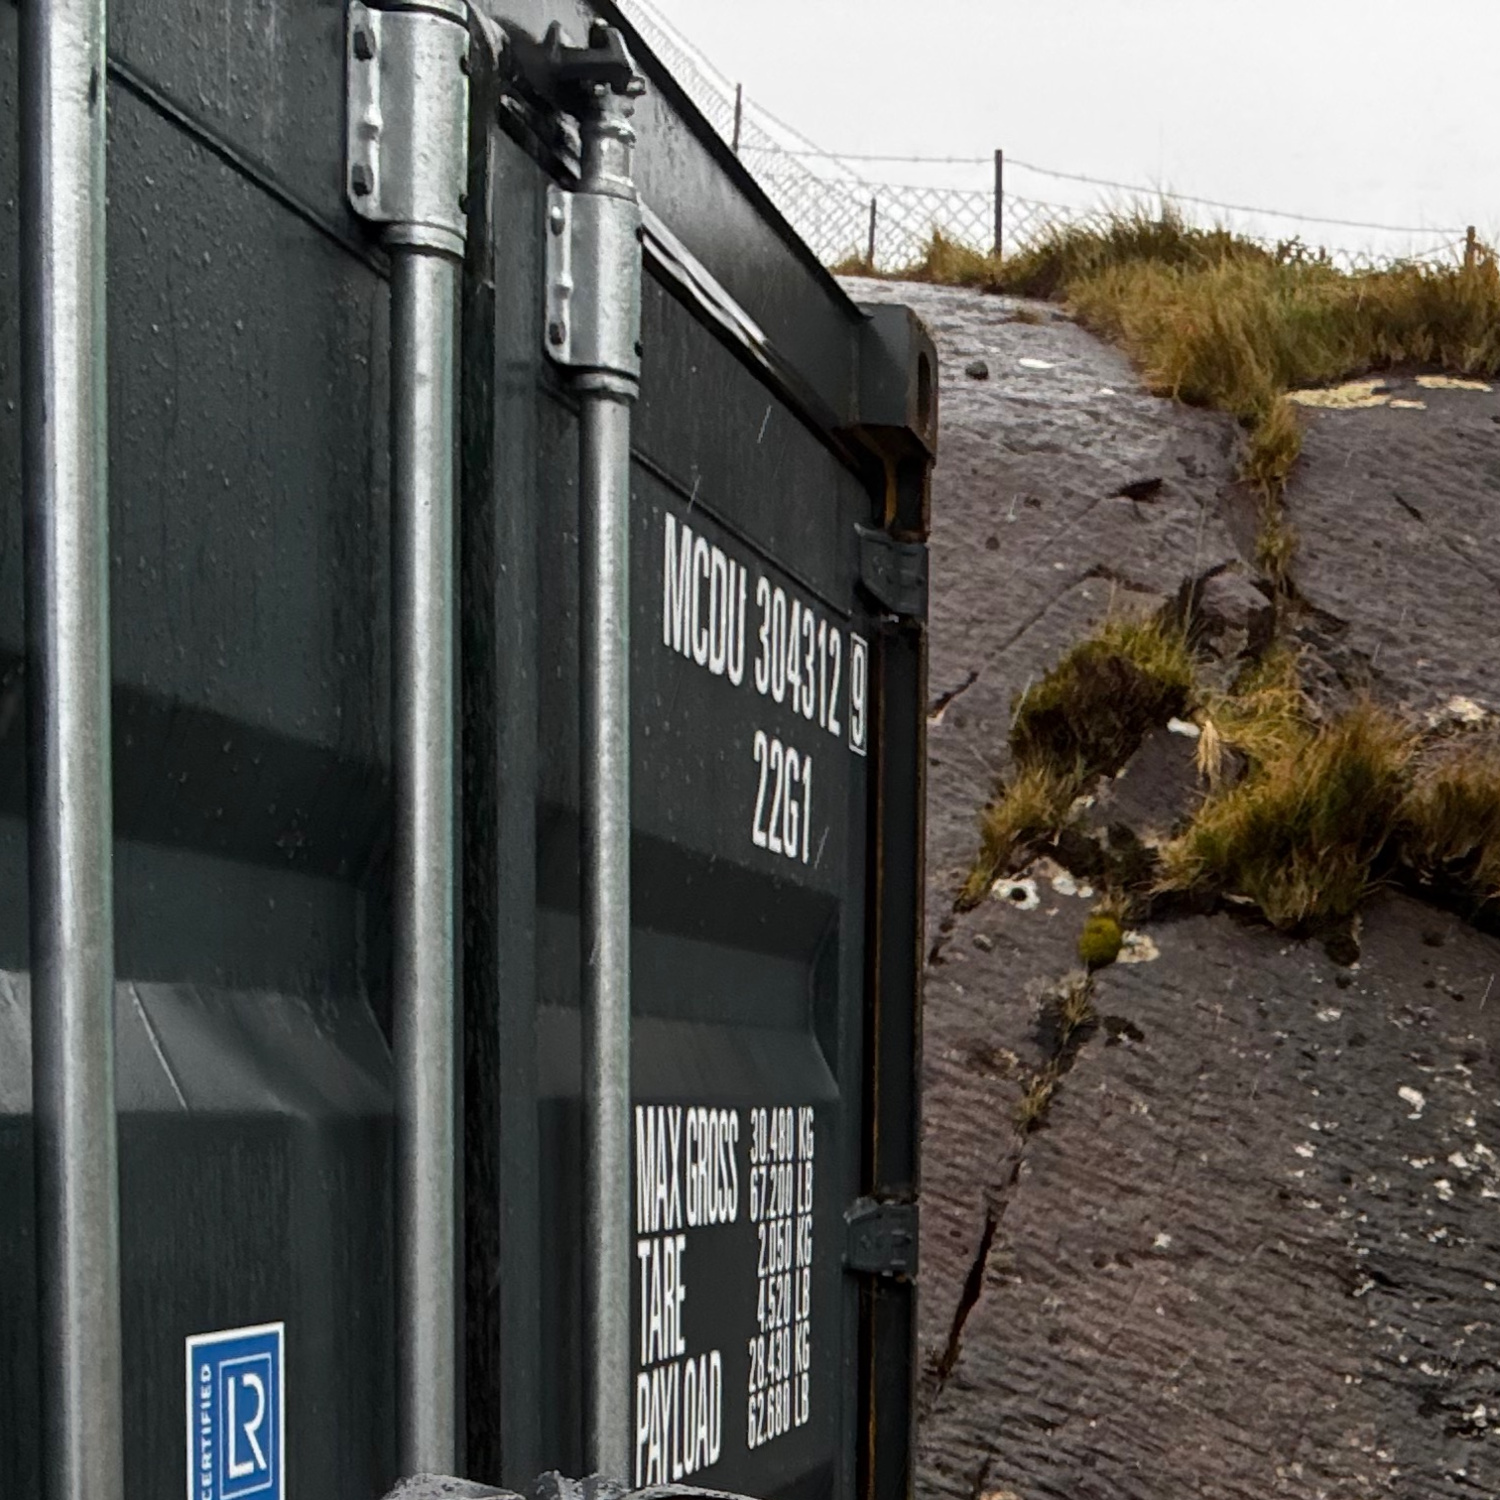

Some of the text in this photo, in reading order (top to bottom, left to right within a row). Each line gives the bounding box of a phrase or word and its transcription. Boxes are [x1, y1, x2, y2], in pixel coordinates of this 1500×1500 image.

[662, 511, 747, 687] MCDU
[754, 575, 842, 737] 304312
[751, 729, 814, 864] 22G1
[635, 1105, 682, 1234] MAX
[685, 1106, 740, 1228] GROSS
[797, 1105, 815, 1161] KG
[796, 1160, 814, 1214] LB
[637, 1233, 687, 1366] TARE
[795, 1213, 813, 1269] KG
[794, 1266, 811, 1321] LB
[635, 1349, 723, 1488] PAYLOAD
[793, 1321, 811, 1373] KG
[793, 1371, 811, 1427] LB
